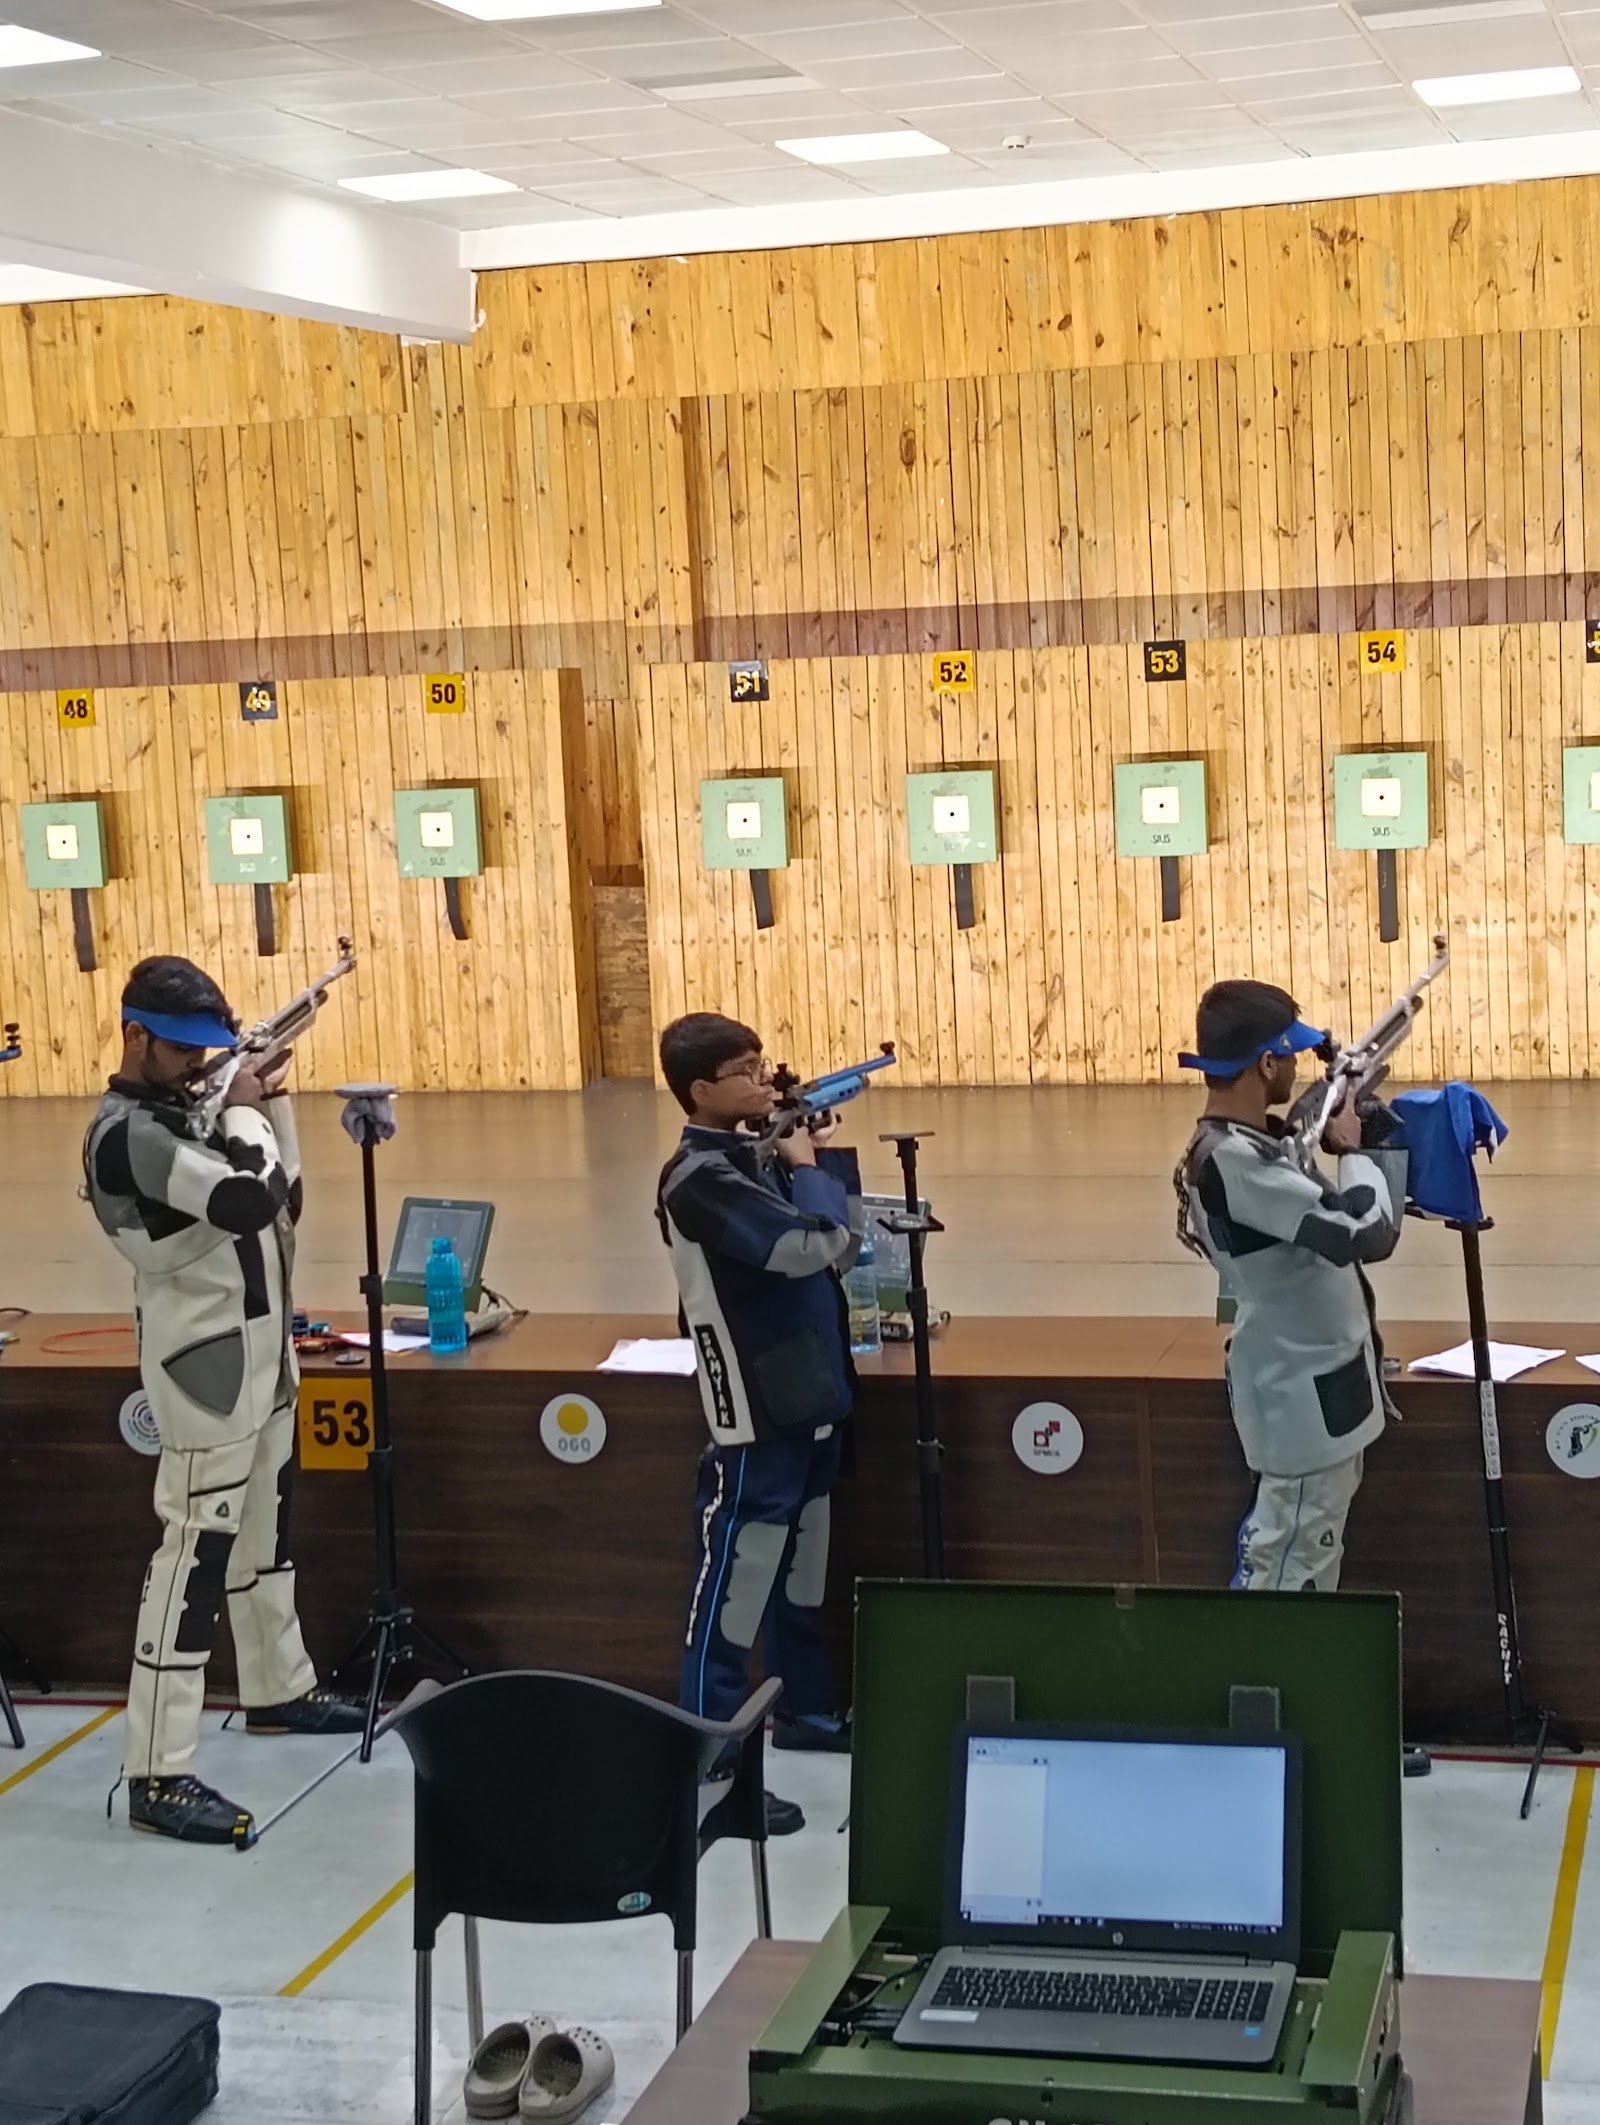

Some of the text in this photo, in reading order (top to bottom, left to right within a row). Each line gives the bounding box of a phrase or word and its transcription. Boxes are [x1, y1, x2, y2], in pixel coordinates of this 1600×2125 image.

[1150, 649, 1179, 673] 53
[1367, 640, 1396, 663] 54
[735, 671, 761, 693] 51
[939, 661, 967, 683] 52
[246, 690, 271, 712] 49
[431, 683, 456, 704] 50
[64, 698, 88, 719] 48
[701, 1332, 730, 1426] SAMYAK
[313, 1400, 370, 1448] 53
